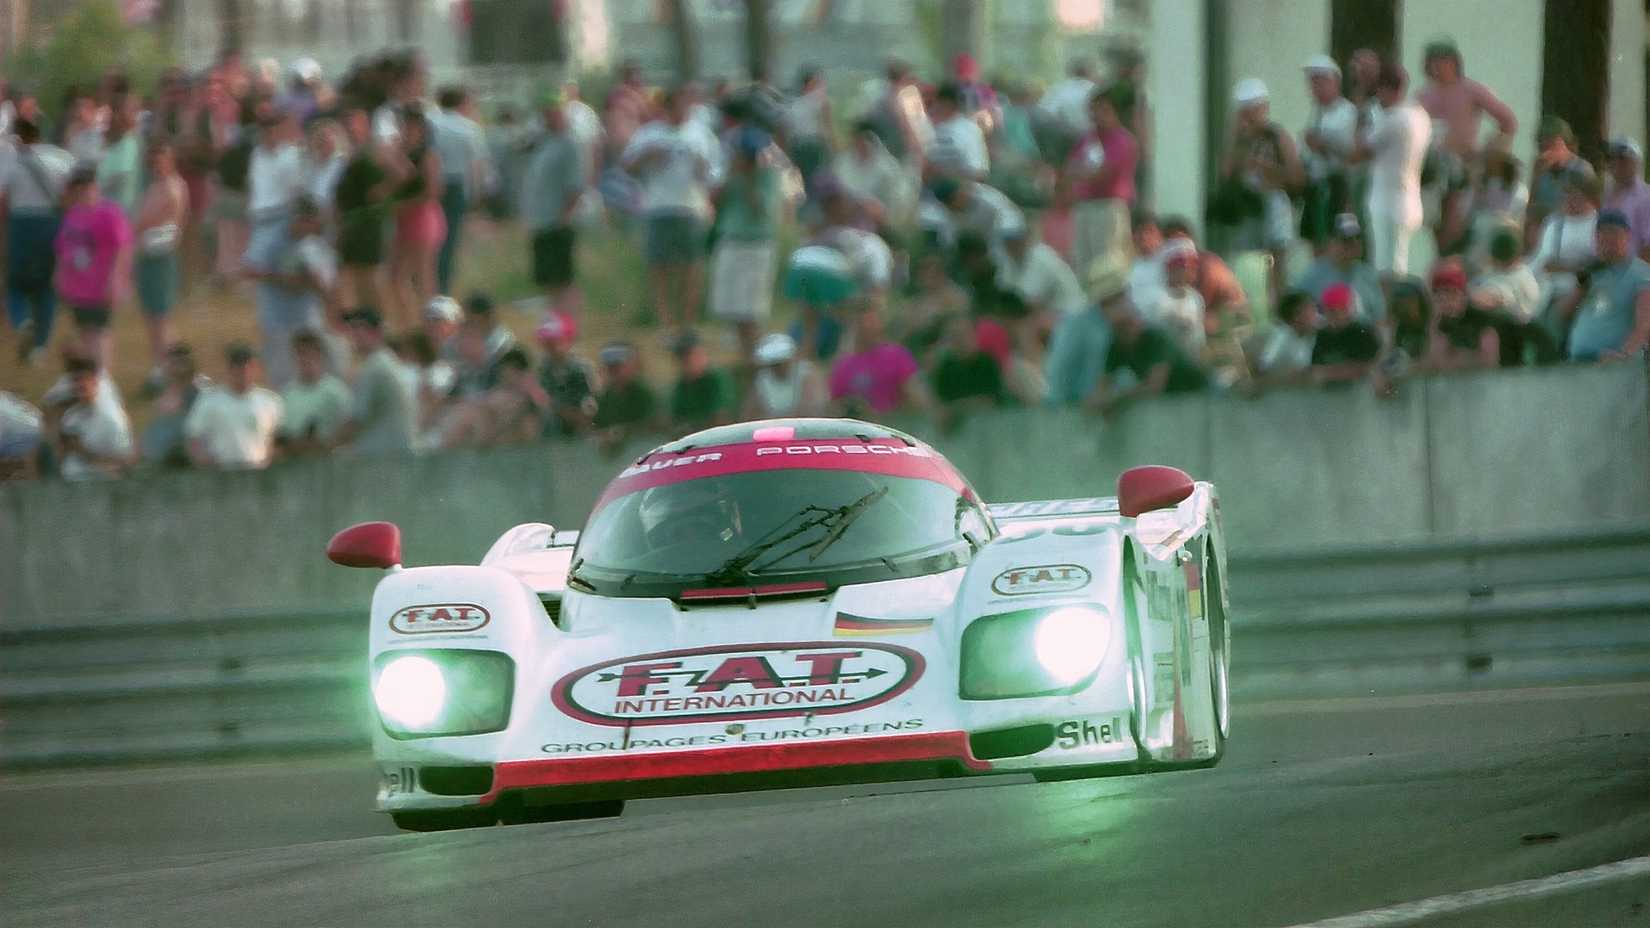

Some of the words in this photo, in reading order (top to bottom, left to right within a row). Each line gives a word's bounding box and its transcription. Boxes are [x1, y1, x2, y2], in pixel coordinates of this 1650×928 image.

[617, 651, 863, 697] F.A.T.
[614, 688, 855, 714] INTERNATIONAL
[541, 734, 727, 754] GROUPAGES
